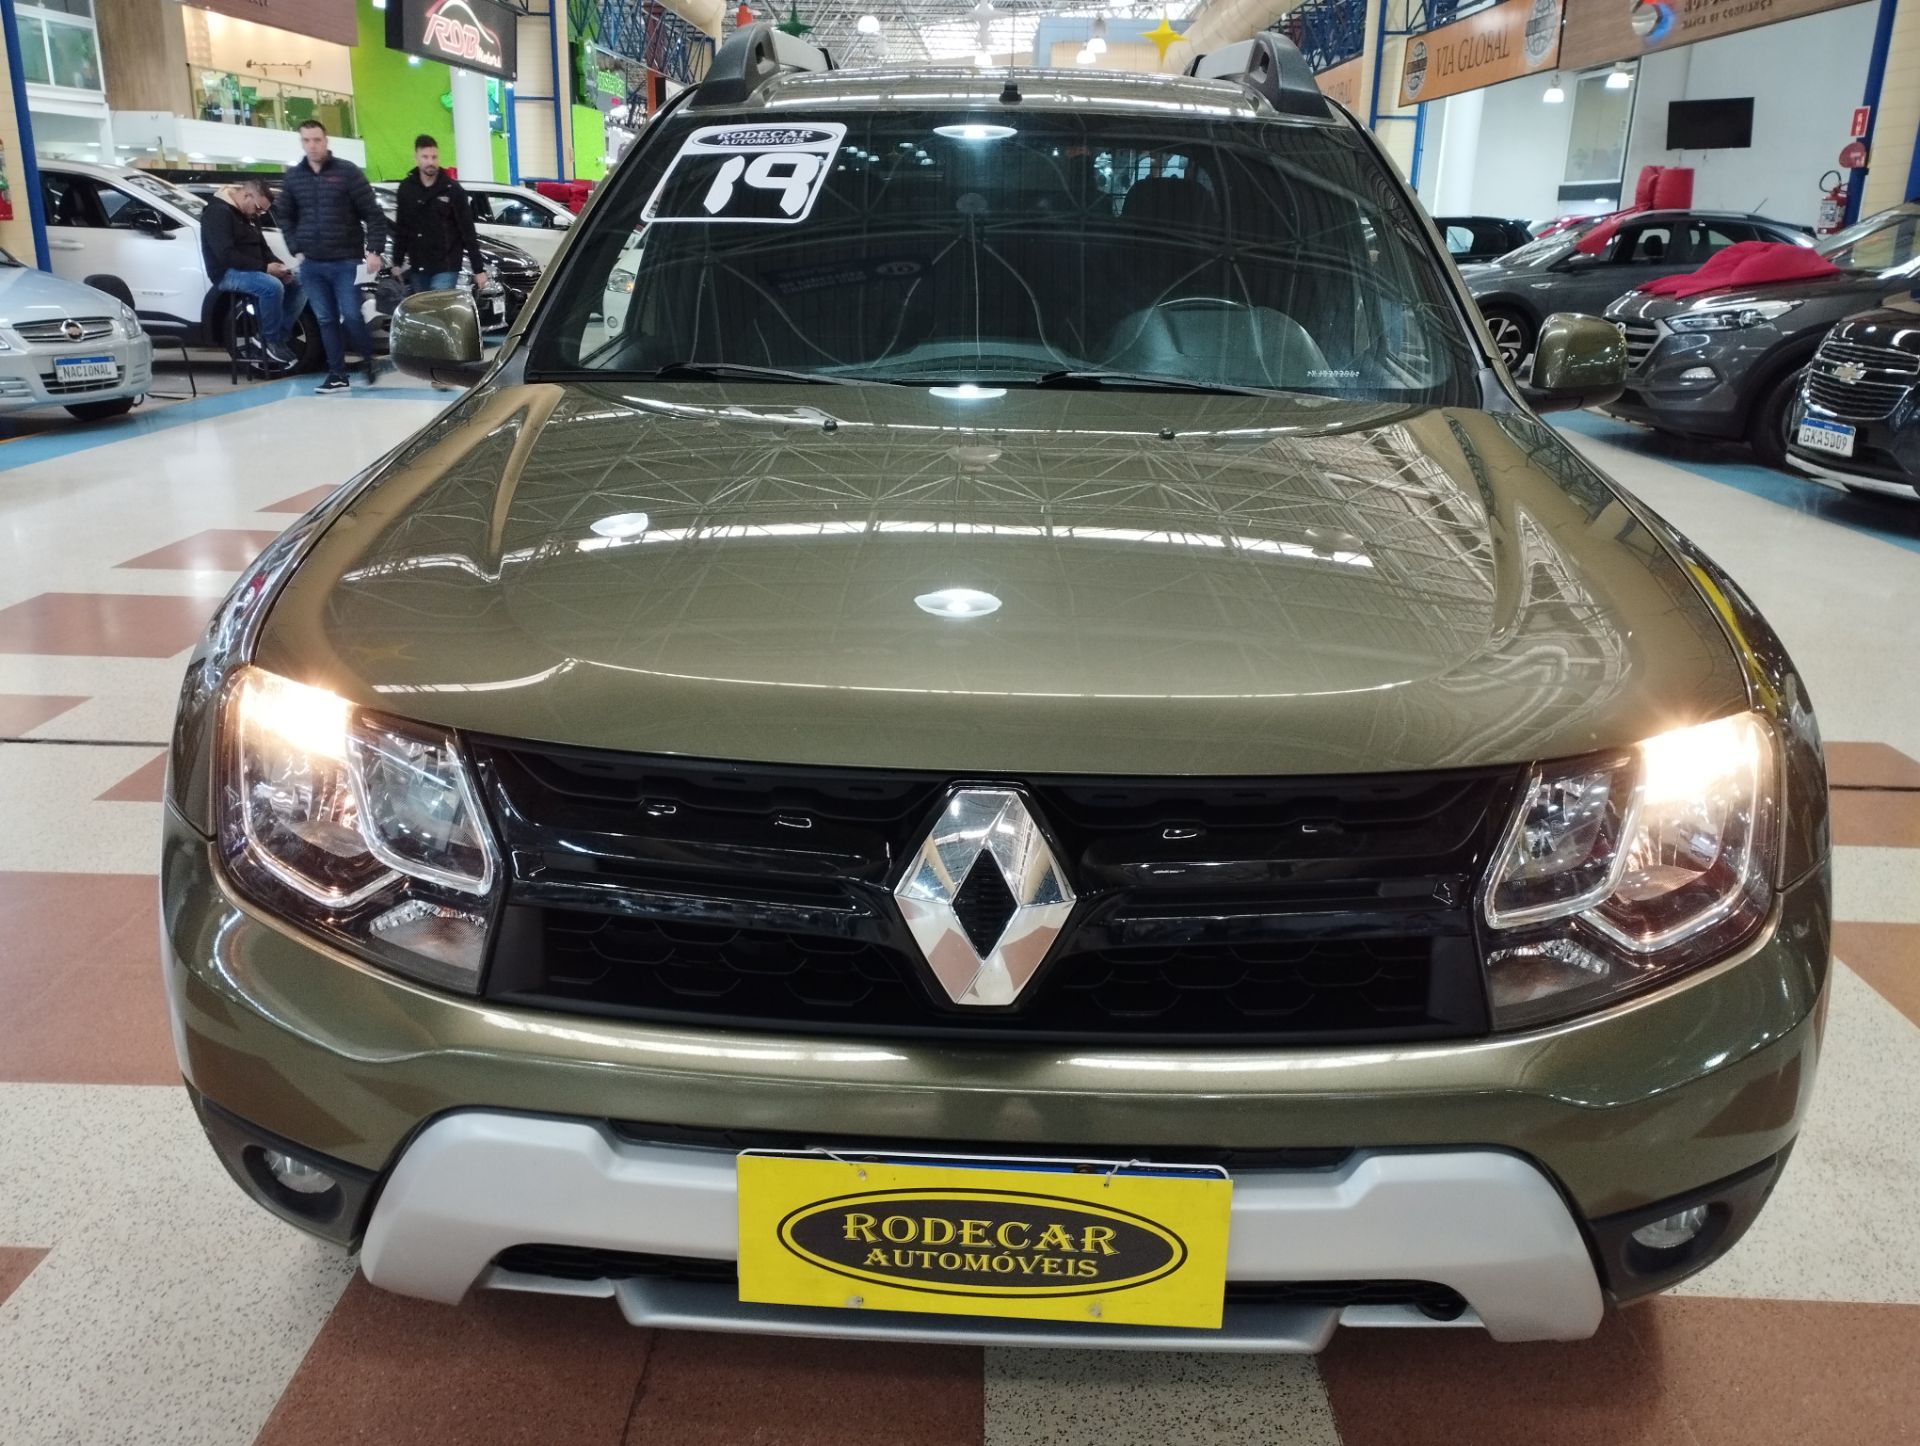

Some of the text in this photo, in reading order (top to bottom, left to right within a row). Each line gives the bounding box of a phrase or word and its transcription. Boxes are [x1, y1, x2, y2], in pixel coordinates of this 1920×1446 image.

[1436, 44, 1455, 78] VIA
[1458, 24, 1511, 72] GLOBAL
[717, 130, 813, 140] RODECAR
[703, 152, 820, 216] 19
[63, 364, 112, 379] NACIONAL
[1803, 428, 1847, 450] GKA5D09
[843, 1213, 1120, 1256] RODECAR
[863, 1249, 1099, 1278] AUTOMÓVEIS
